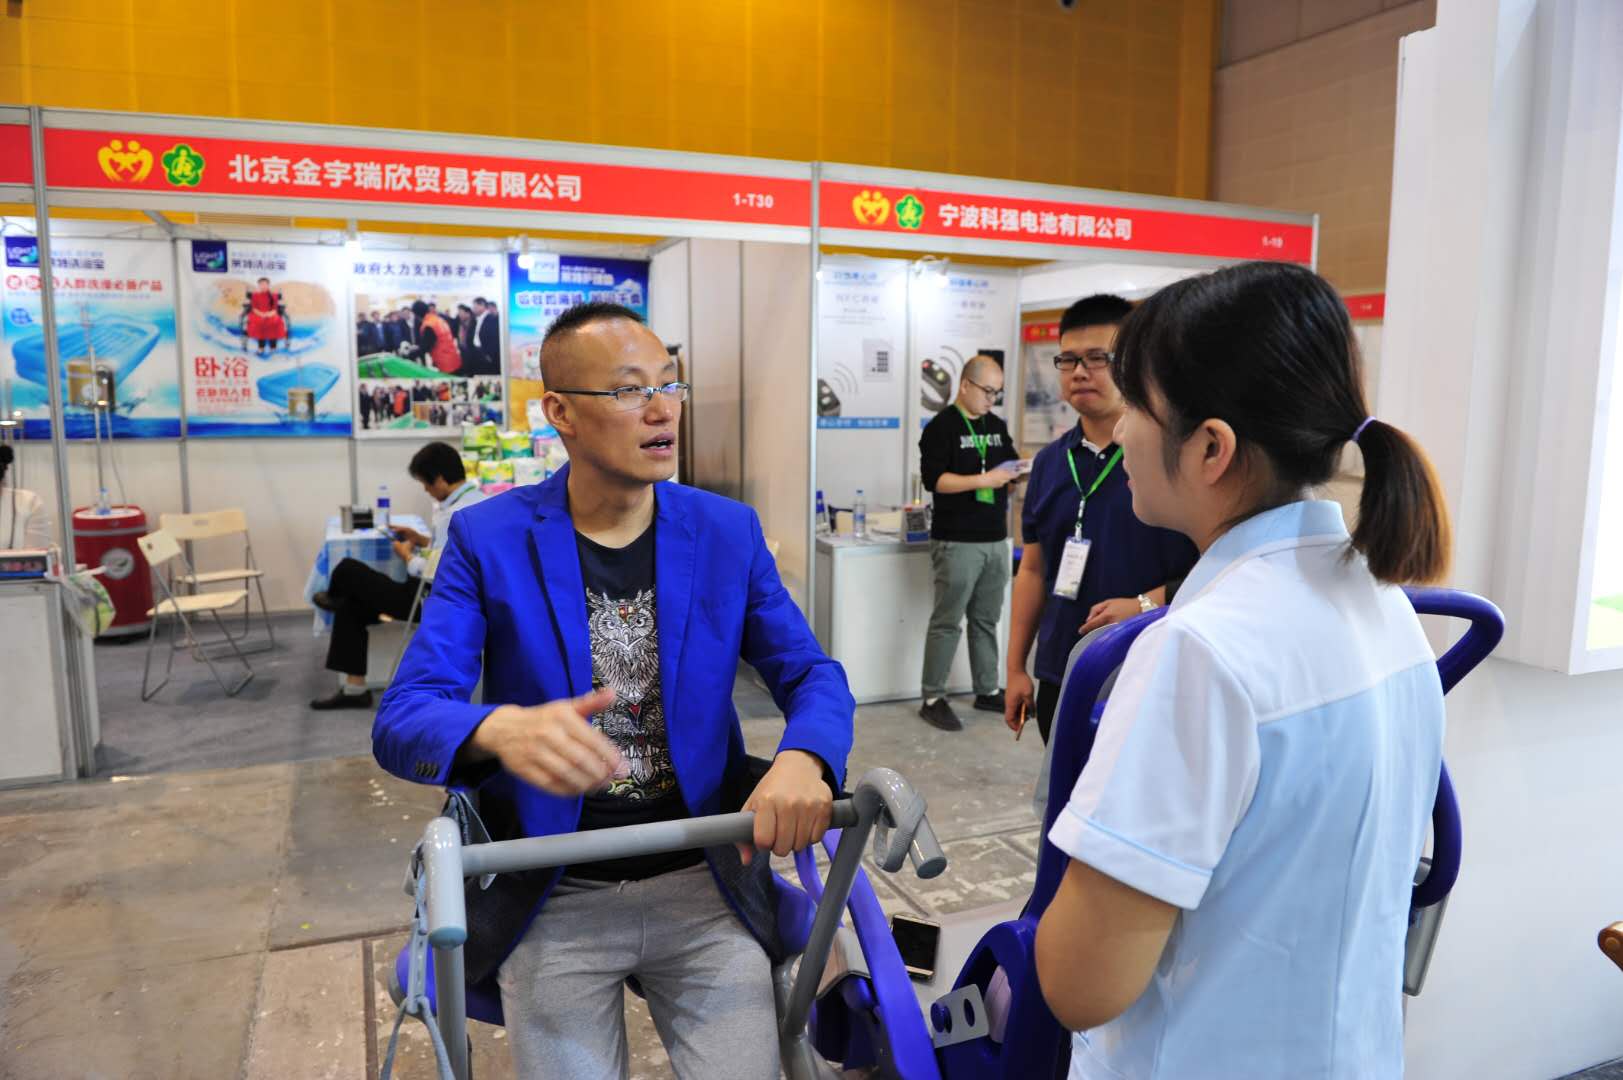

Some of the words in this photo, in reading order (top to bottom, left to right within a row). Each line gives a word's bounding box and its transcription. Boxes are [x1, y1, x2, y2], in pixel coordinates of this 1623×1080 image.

[228, 153, 582, 203] 北京金宇瑞欣贸易有限公司
[732, 192, 774, 208] 1-T30
[938, 203, 1133, 241] 宁波科强电池有限公司
[353, 261, 495, 278] 政府大力支持养老产业
[195, 356, 248, 378] 卧浴
